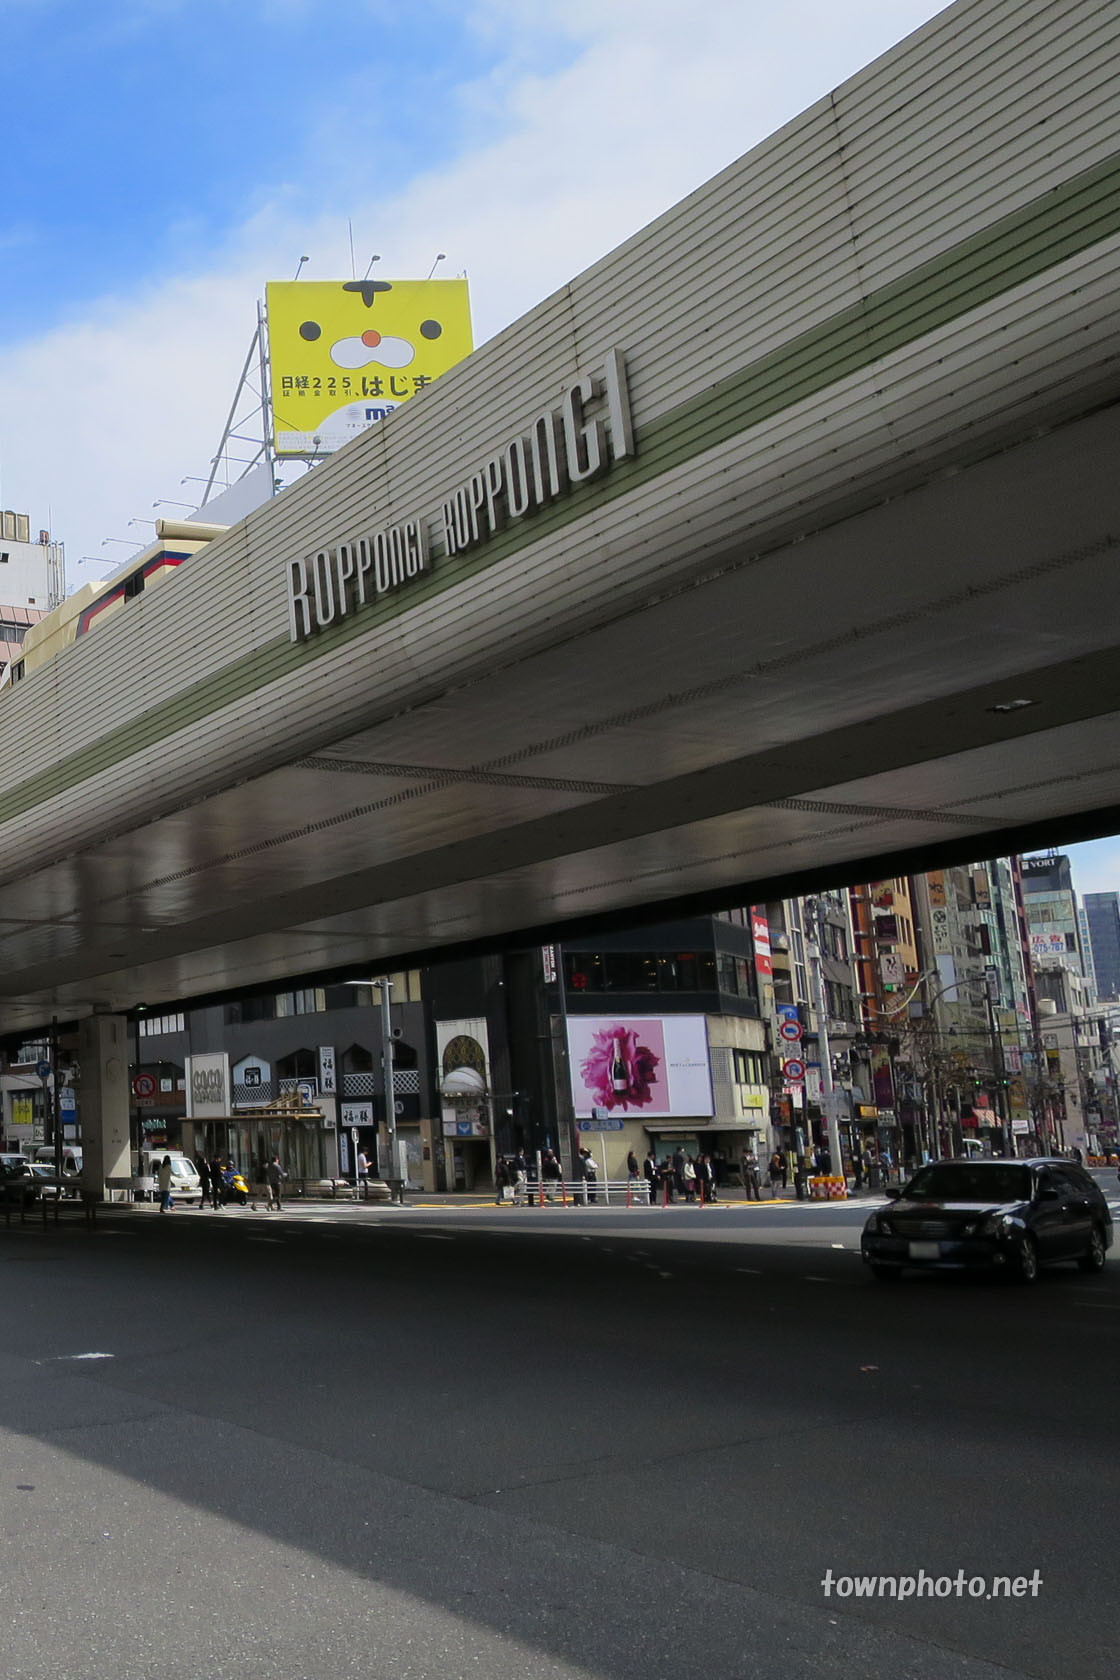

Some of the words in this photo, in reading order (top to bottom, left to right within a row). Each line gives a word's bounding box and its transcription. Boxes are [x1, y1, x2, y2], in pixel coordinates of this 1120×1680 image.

[285, 517, 429, 643] ROPPONGI
[441, 347, 635, 556] ROPPONGI
[1030, 859, 1056, 868] VORT
